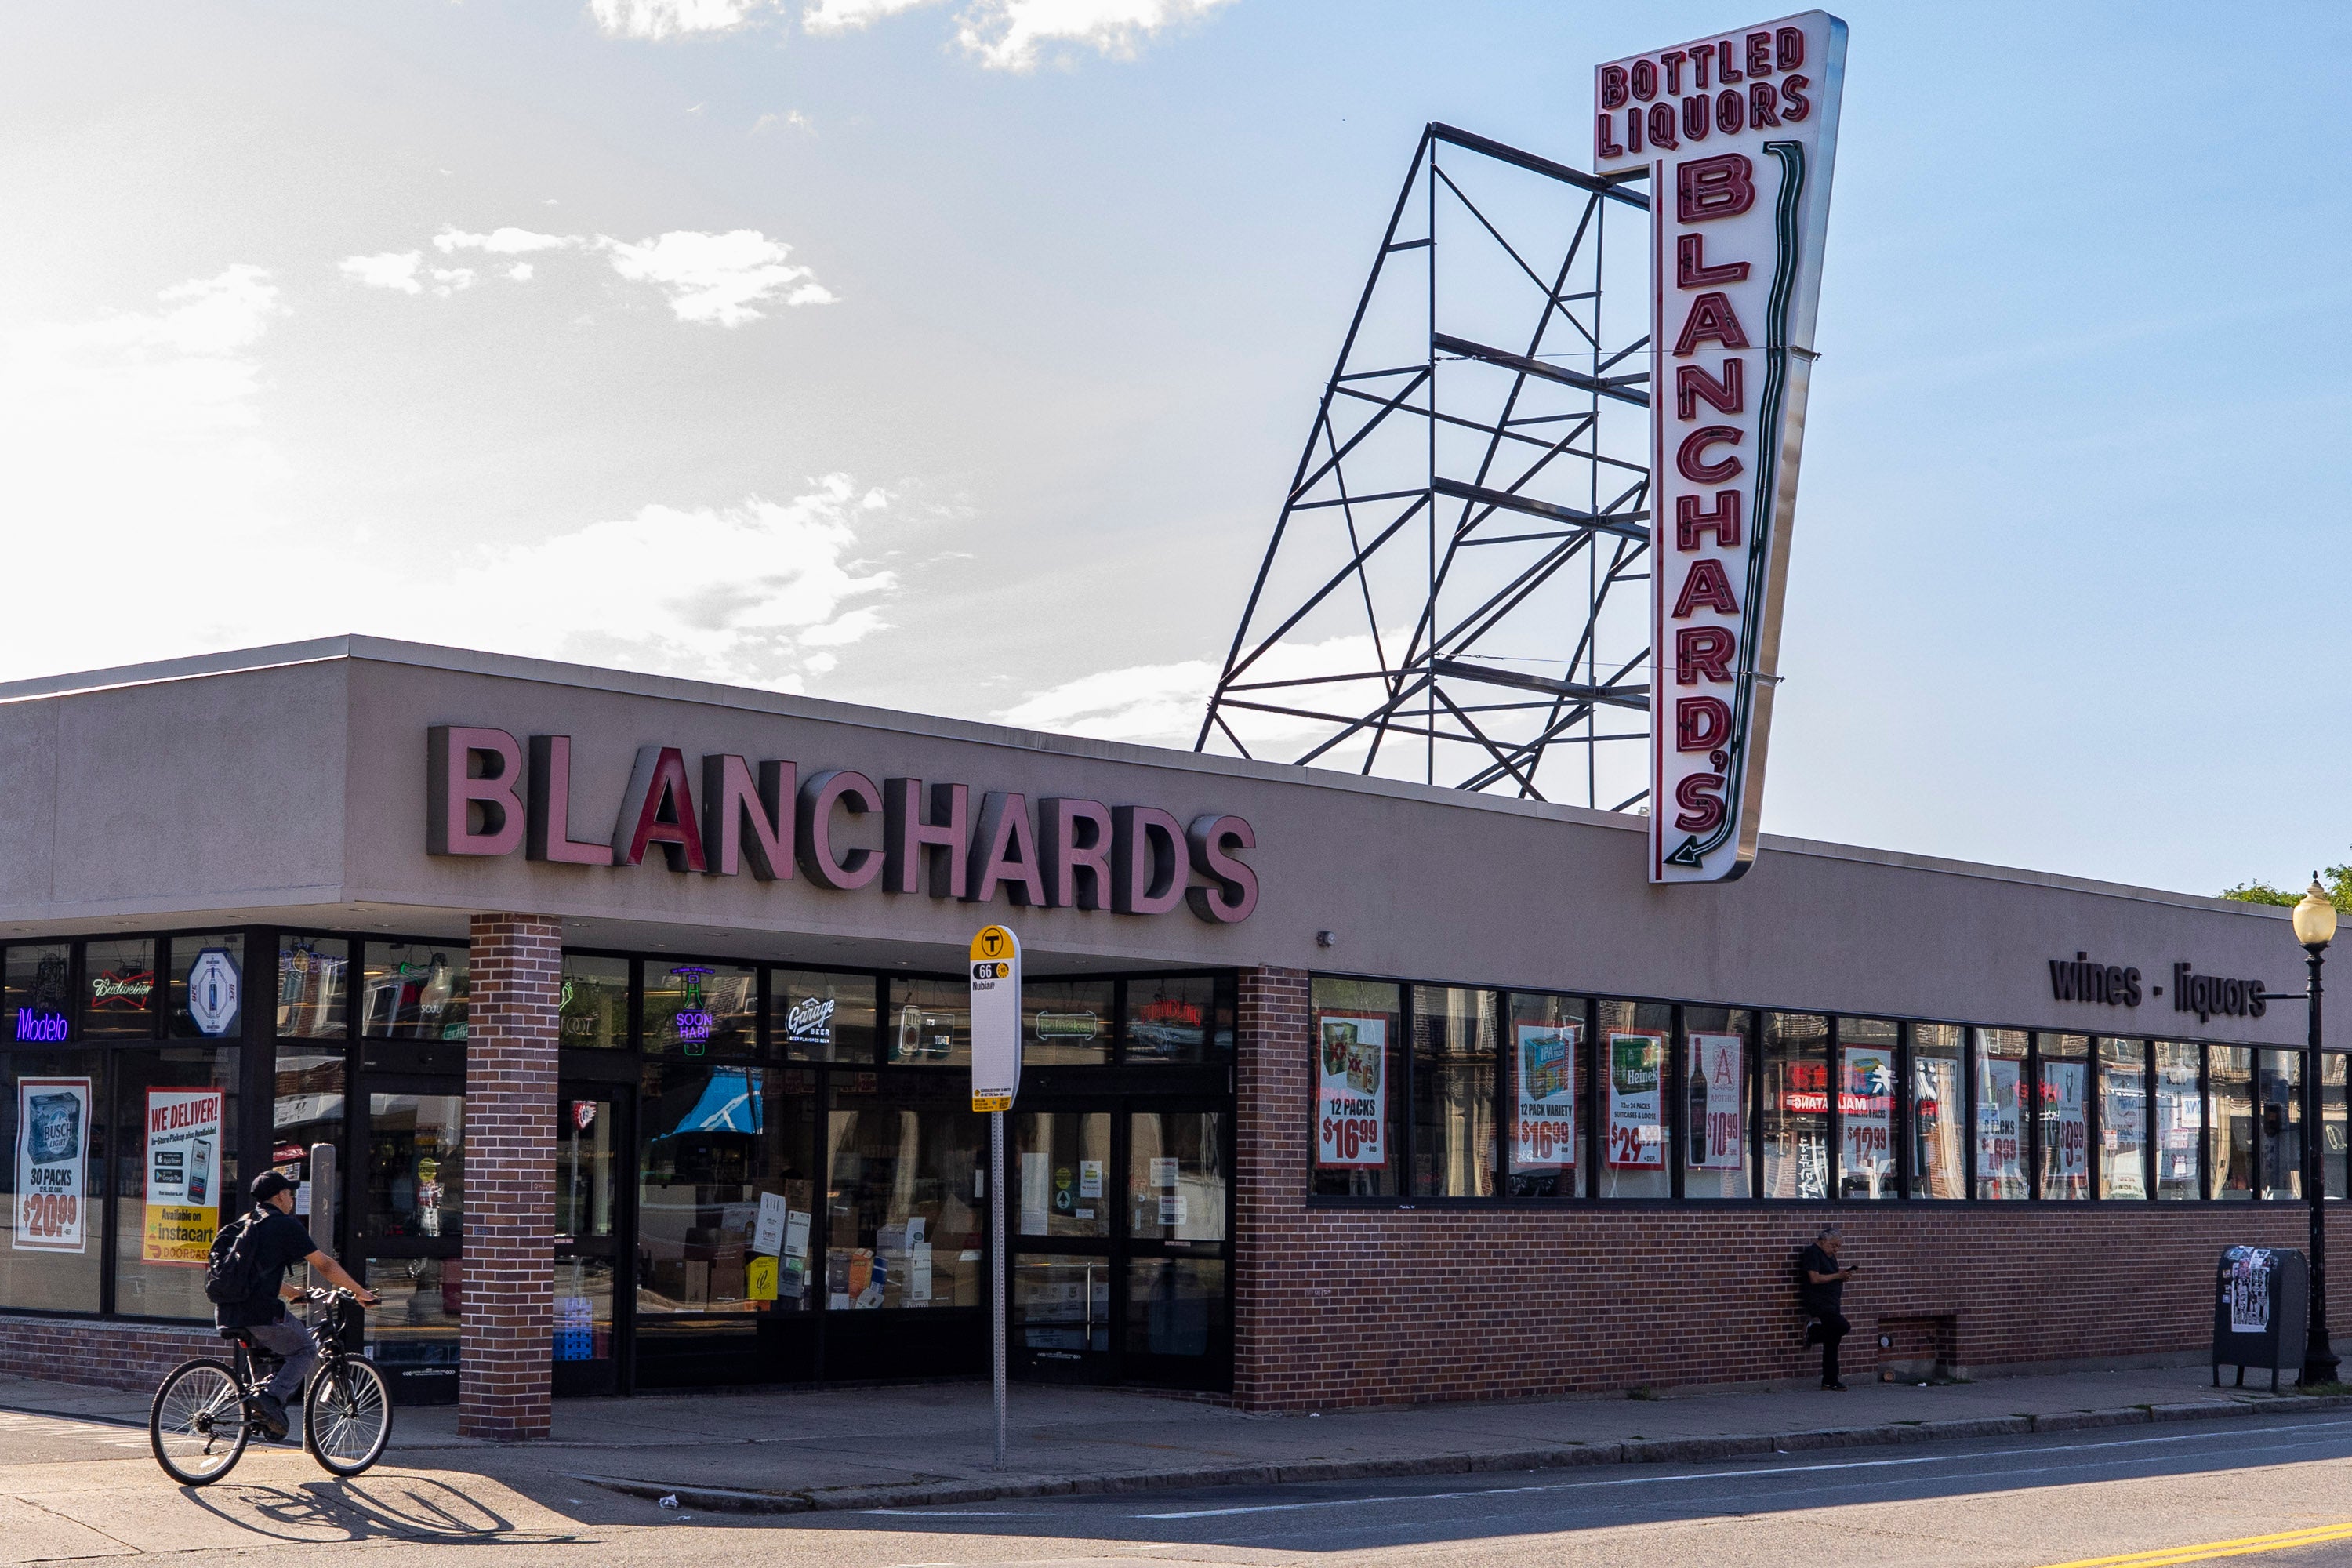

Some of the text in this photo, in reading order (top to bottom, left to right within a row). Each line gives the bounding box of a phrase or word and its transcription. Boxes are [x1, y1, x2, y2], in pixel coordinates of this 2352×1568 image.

[1601, 27, 1804, 110] BOTTLED
[1598, 74, 1809, 159] LIQUORS
[427, 724, 1258, 924] BLANCHARDS
[979, 964, 992, 978] 66
[93, 978, 154, 997] Budweiser
[2049, 952, 2142, 1007] wines
[2174, 961, 2267, 1022] liquors
[420, 1004, 444, 1014] SOJU
[788, 998, 835, 1033] Garage
[16, 1007, 68, 1042] Modelo
[676, 1013, 713, 1026] SOON
[1040, 1018, 1095, 1033] Heineken
[679, 1026, 709, 1039] HARI
[810, 1028, 830, 1036] BEER
[1541, 1046, 1553, 1062] IPA
[1348, 1056, 1363, 1073] XX
[1710, 1094, 1736, 1103] APOTHIC
[151, 1096, 219, 1133] WE DELIVER!
[1330, 1098, 1375, 1116] 12 PACKS
[1520, 1104, 1573, 1117] 12 PACK VARIETY
[1872, 1109, 1886, 1119] PACKS
[43, 1123, 73, 1142] BUSCH
[151, 1136, 169, 1146] In-Store
[169, 1133, 185, 1143] Pickup
[49, 1138, 67, 1149] LIGHT
[31, 1168, 72, 1186] 30 PACKS
[162, 1208, 201, 1221] Available on
[158, 1223, 214, 1243] instacart
[163, 1247, 210, 1261] DOORDAS
